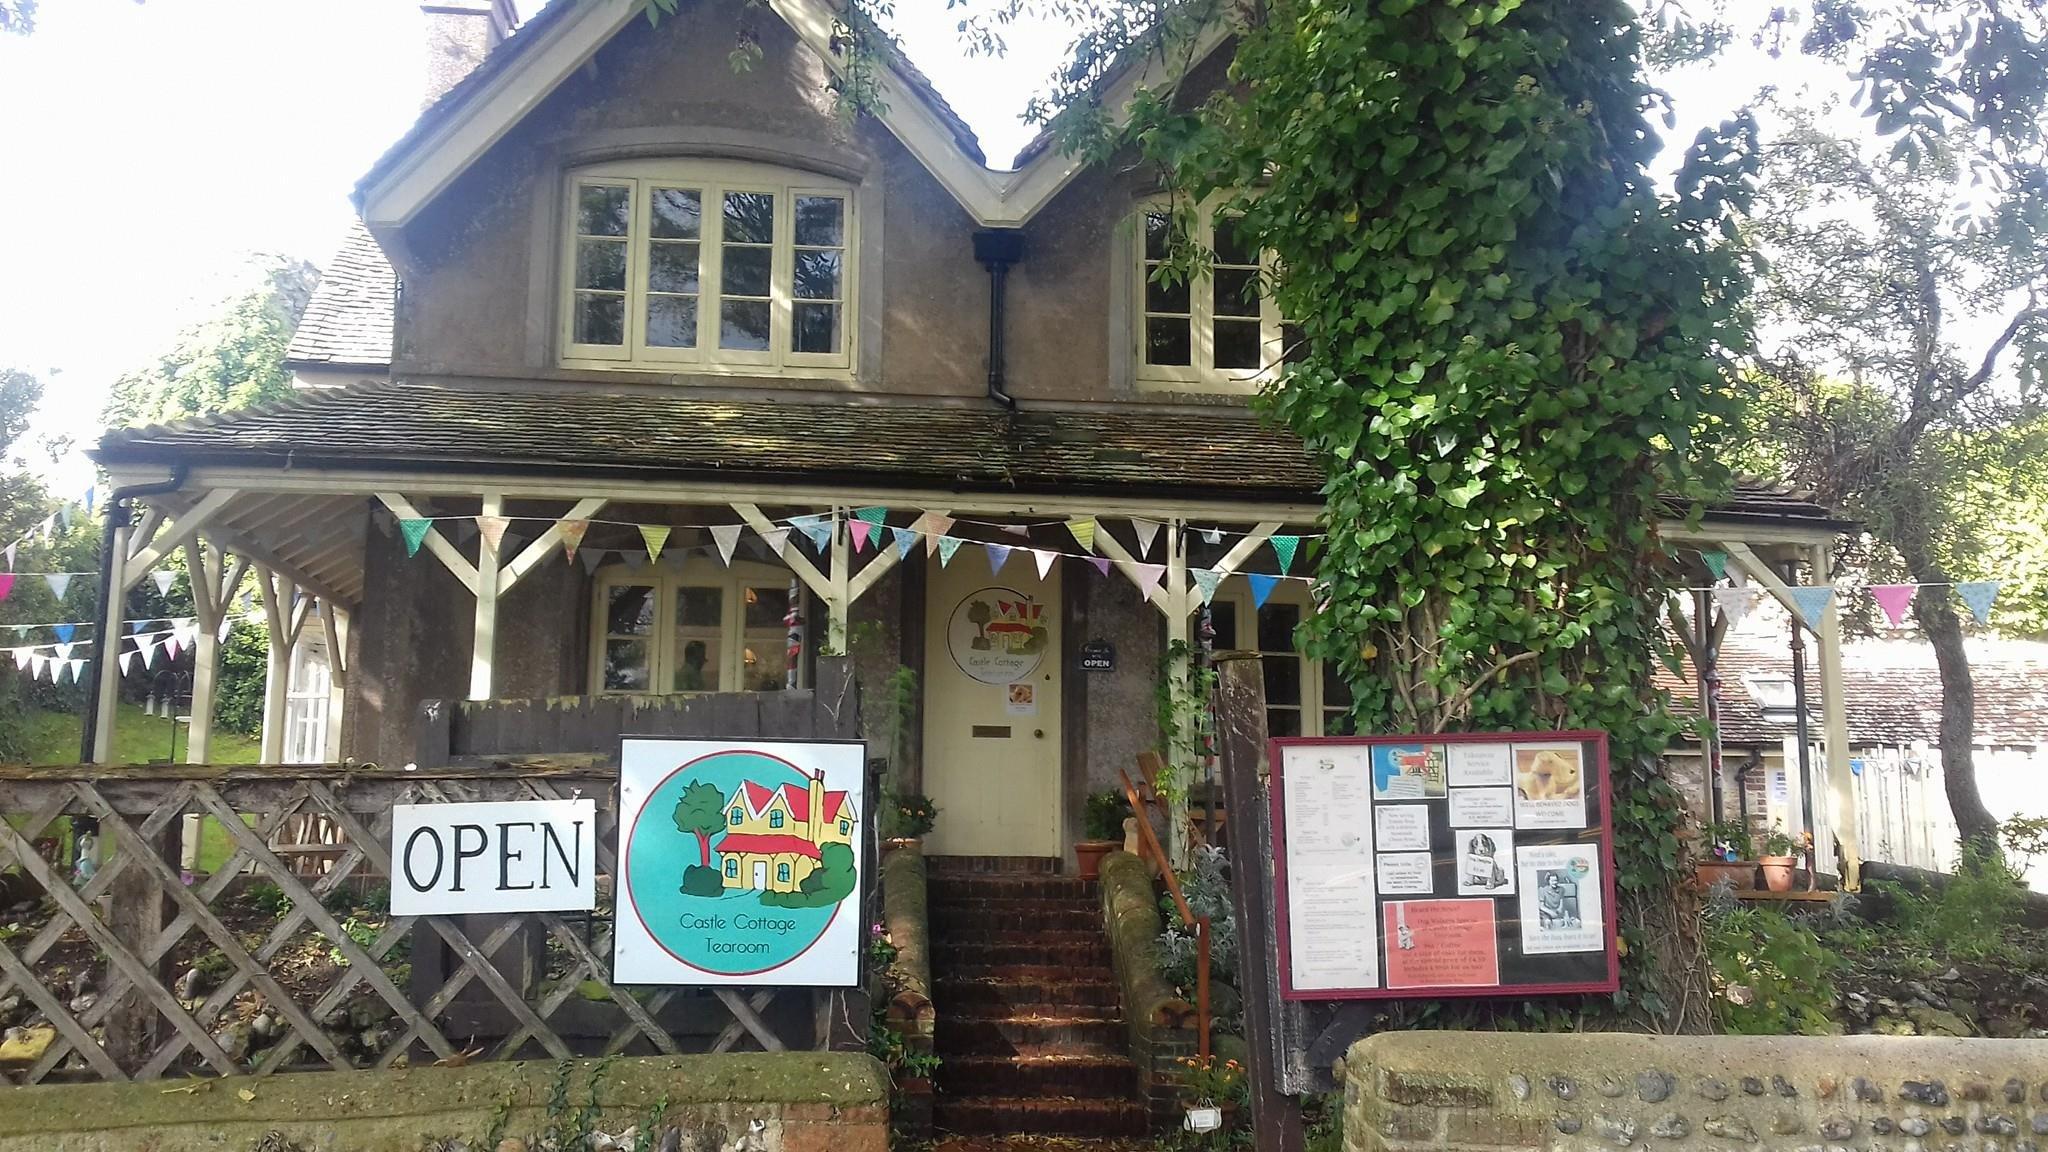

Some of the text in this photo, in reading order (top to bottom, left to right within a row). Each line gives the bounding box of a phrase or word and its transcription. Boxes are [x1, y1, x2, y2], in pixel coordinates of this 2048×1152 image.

[1084, 659, 1110, 667] OPEN
[403, 821, 584, 892] OPEN
[680, 912, 796, 935] Castle Cottage
[705, 937, 770, 954] Tearoom
